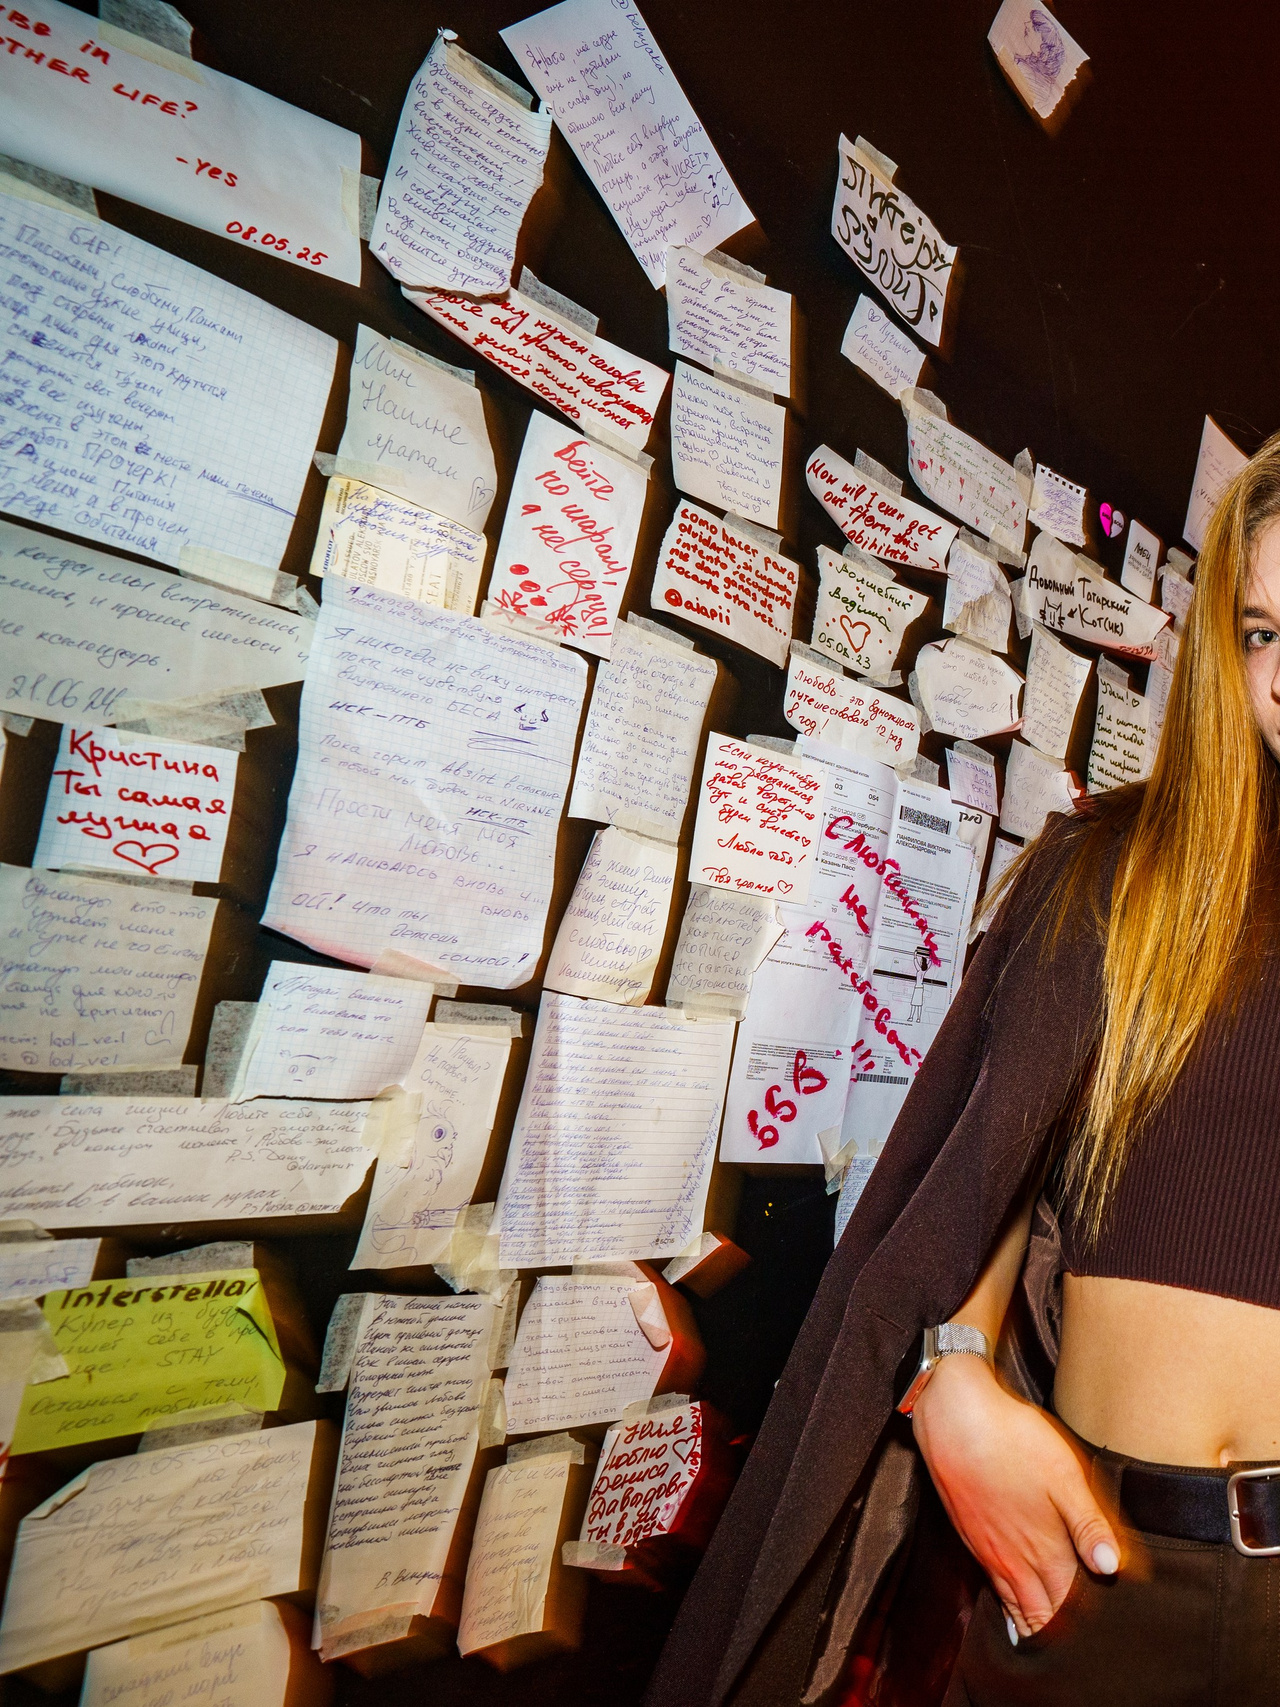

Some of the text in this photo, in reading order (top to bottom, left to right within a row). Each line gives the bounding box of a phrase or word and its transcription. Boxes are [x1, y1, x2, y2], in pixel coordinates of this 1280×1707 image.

[80, 40, 110, 64] in
[113, 84, 198, 118] LIFE?
[226, 221, 328, 266] 08.05.25
[355, 342, 416, 388] Мин
[823, 491, 847, 508] out
[893, 533, 919, 552] this
[842, 484, 867, 501] will
[865, 492, 878, 509] I
[905, 520, 942, 540] get
[681, 508, 797, 585] como hacer para
[349, 552, 362, 580] ULATOV
[358, 558, 369, 582] OSCOW
[367, 540, 383, 585] RASNOYARSK
[676, 533, 791, 610] intento recordarte
[666, 558, 720, 595] tocarte
[724, 592, 750, 611] otra
[695, 562, 719, 578] dan
[723, 576, 757, 602] ganas
[760, 598, 774, 613] de
[755, 569, 792, 597] cuando
[836, 564, 910, 610] Волшебник
[1029, 565, 1075, 597] Довольный
[858, 592, 866, 602] и
[325, 627, 356, 641] Я
[358, 635, 436, 669] никогда
[336, 651, 381, 671] пока
[819, 632, 871, 669] 05.08.23
[794, 670, 836, 696] Любовь
[850, 696, 864, 706] это
[446, 700, 503, 722] БЕСА
[787, 702, 799, 718] в
[1098, 705, 1104, 719] А
[318, 734, 361, 755] Пока
[719, 743, 753, 761] Если
[876, 725, 886, 737] 12
[886, 730, 903, 751] раз
[69, 729, 218, 782] Кристина
[715, 760, 737, 770] мы
[53, 769, 226, 814] Ты самая
[738, 796, 747, 804] и
[835, 783, 843, 791] 03
[316, 787, 392, 819] Прости
[404, 811, 463, 836] меня
[717, 833, 763, 857] Люблю
[896, 833, 952, 855] ПАНФИЛОВА ВИКТОРИЯ
[896, 840, 937, 856] АЛЕКСАНДРОВНА
[821, 859, 841, 868] Казань
